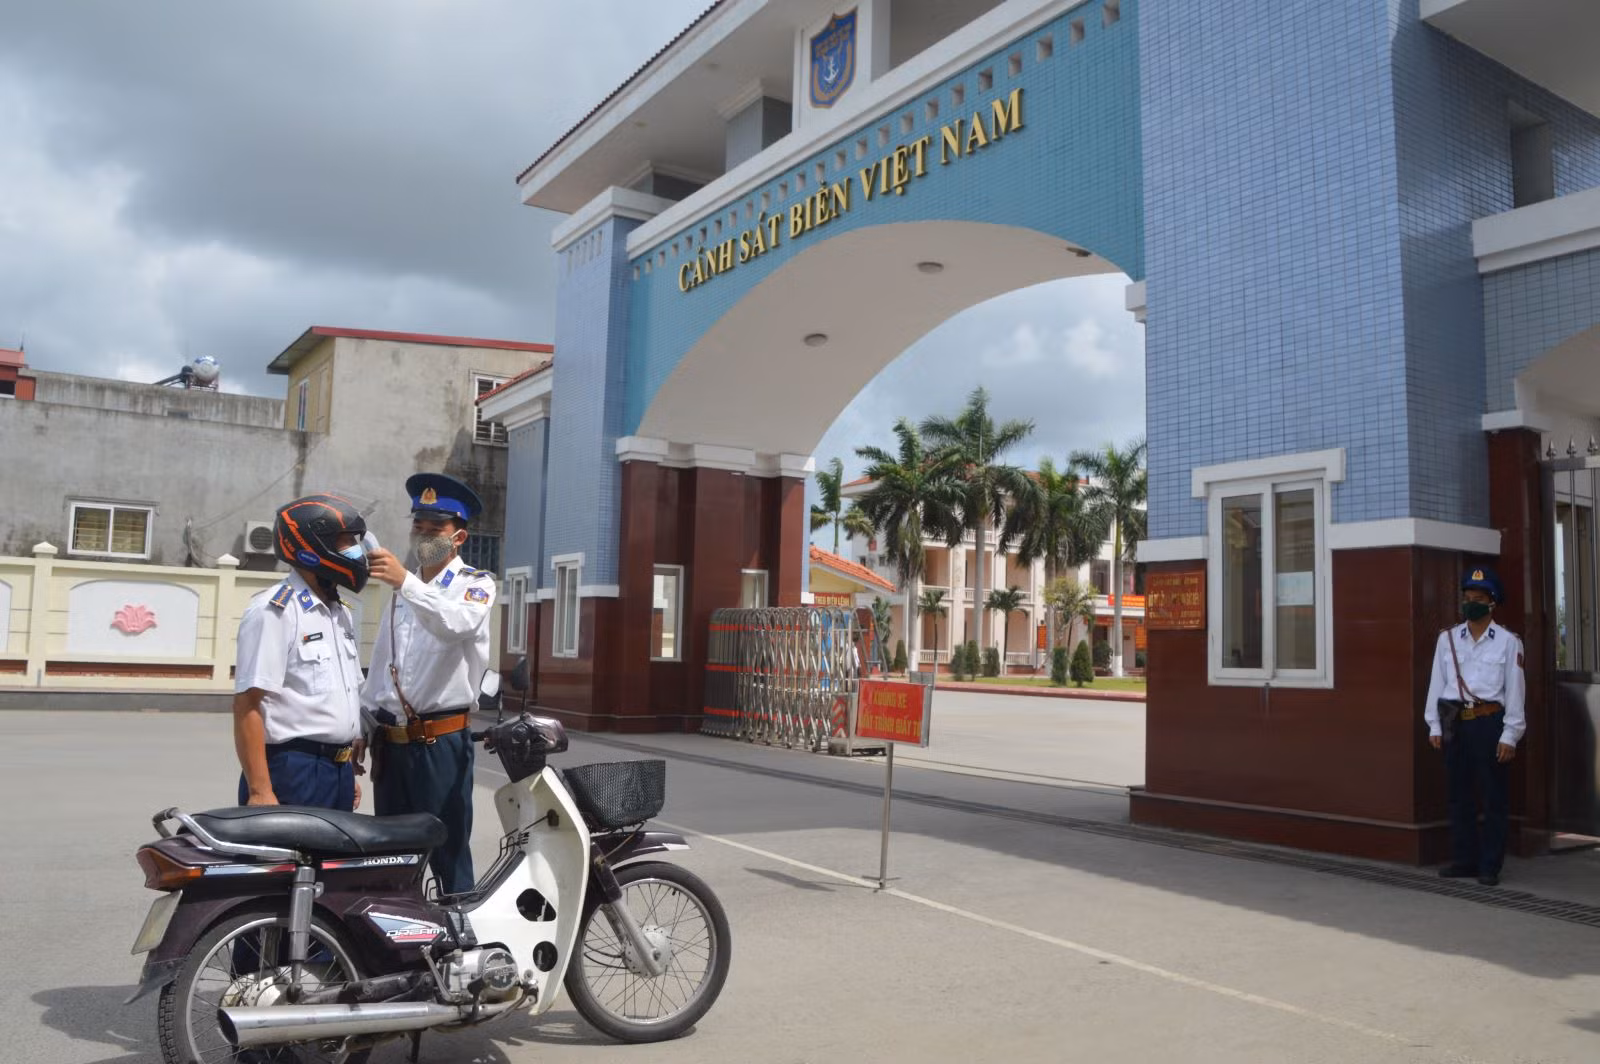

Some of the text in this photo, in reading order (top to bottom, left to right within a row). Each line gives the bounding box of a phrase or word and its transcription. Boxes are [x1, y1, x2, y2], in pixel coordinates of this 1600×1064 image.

[679, 88, 1024, 292] CẢNH SÁT BIỂN VIỆT NAM
[364, 856, 404, 866] HONDA
